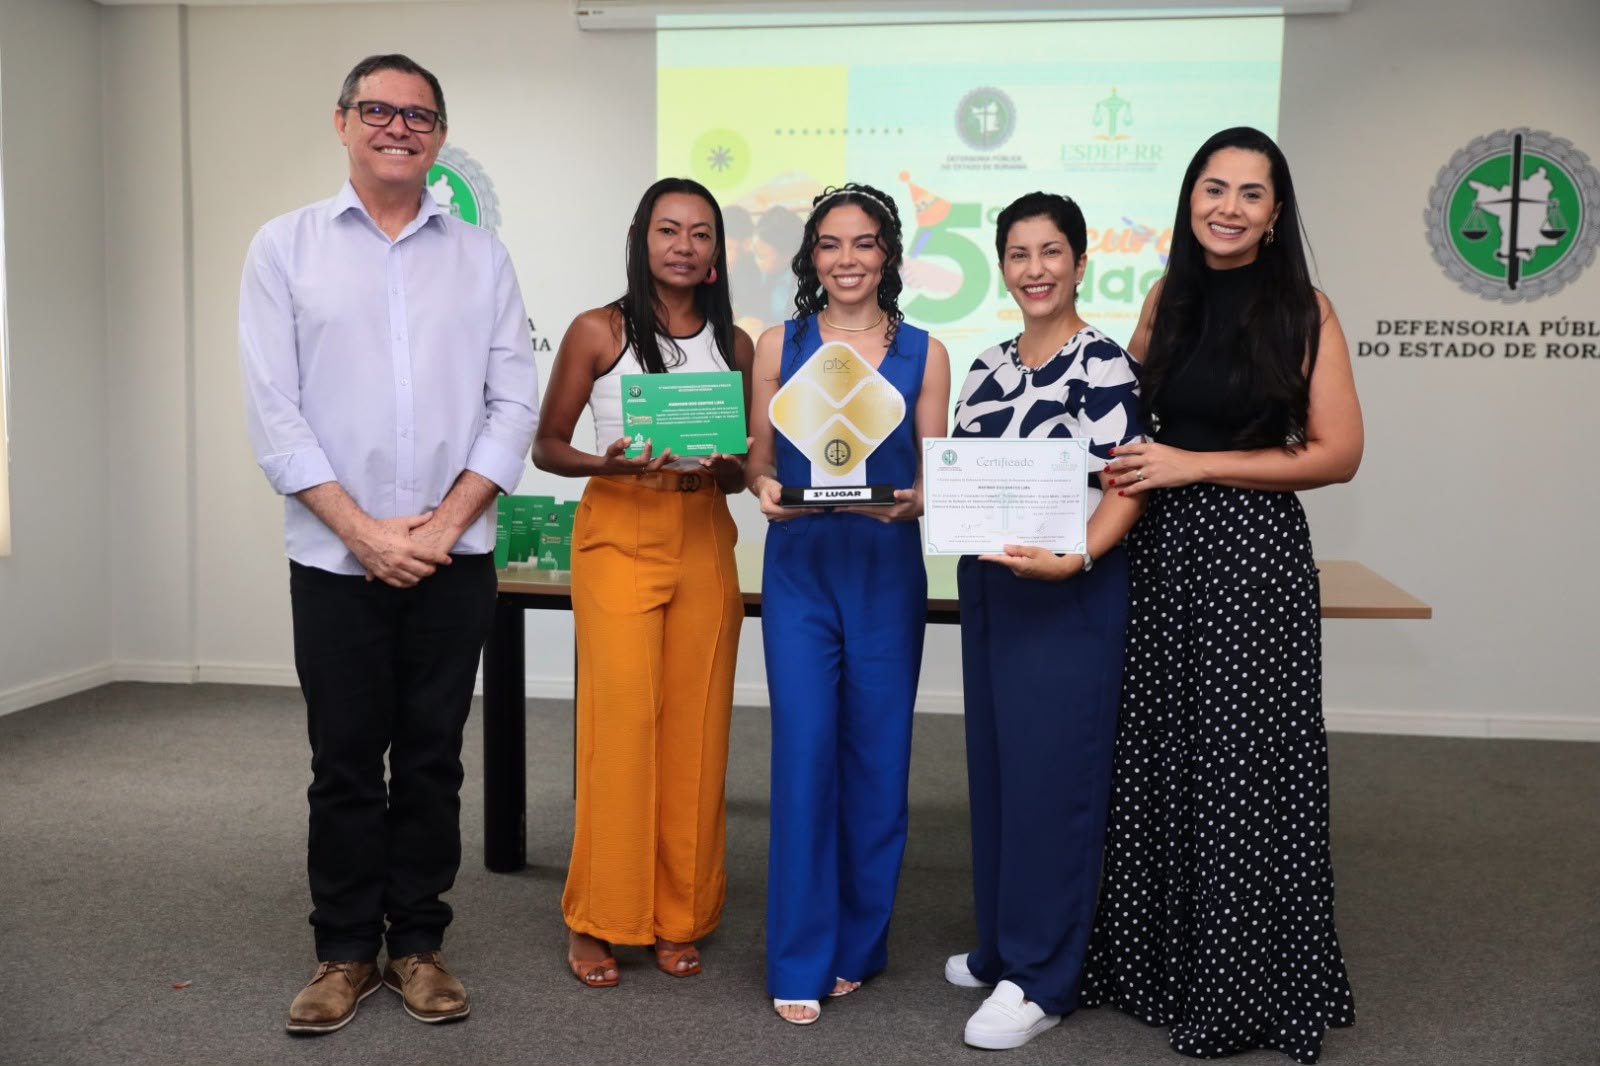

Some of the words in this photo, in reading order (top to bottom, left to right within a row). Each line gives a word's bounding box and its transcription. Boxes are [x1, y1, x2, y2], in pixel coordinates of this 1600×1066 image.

[1059, 144, 1163, 161] ESDEP-RR
[1376, 320, 1530, 336] DEFENSORIA
[1357, 341, 1390, 357] DO
[1399, 342, 1495, 358] ESTADO
[1504, 343, 1536, 359] DE
[1545, 343, 1600, 359] ROR
[976, 456, 1035, 469] Certificado
[825, 490, 862, 498] LUGAR
